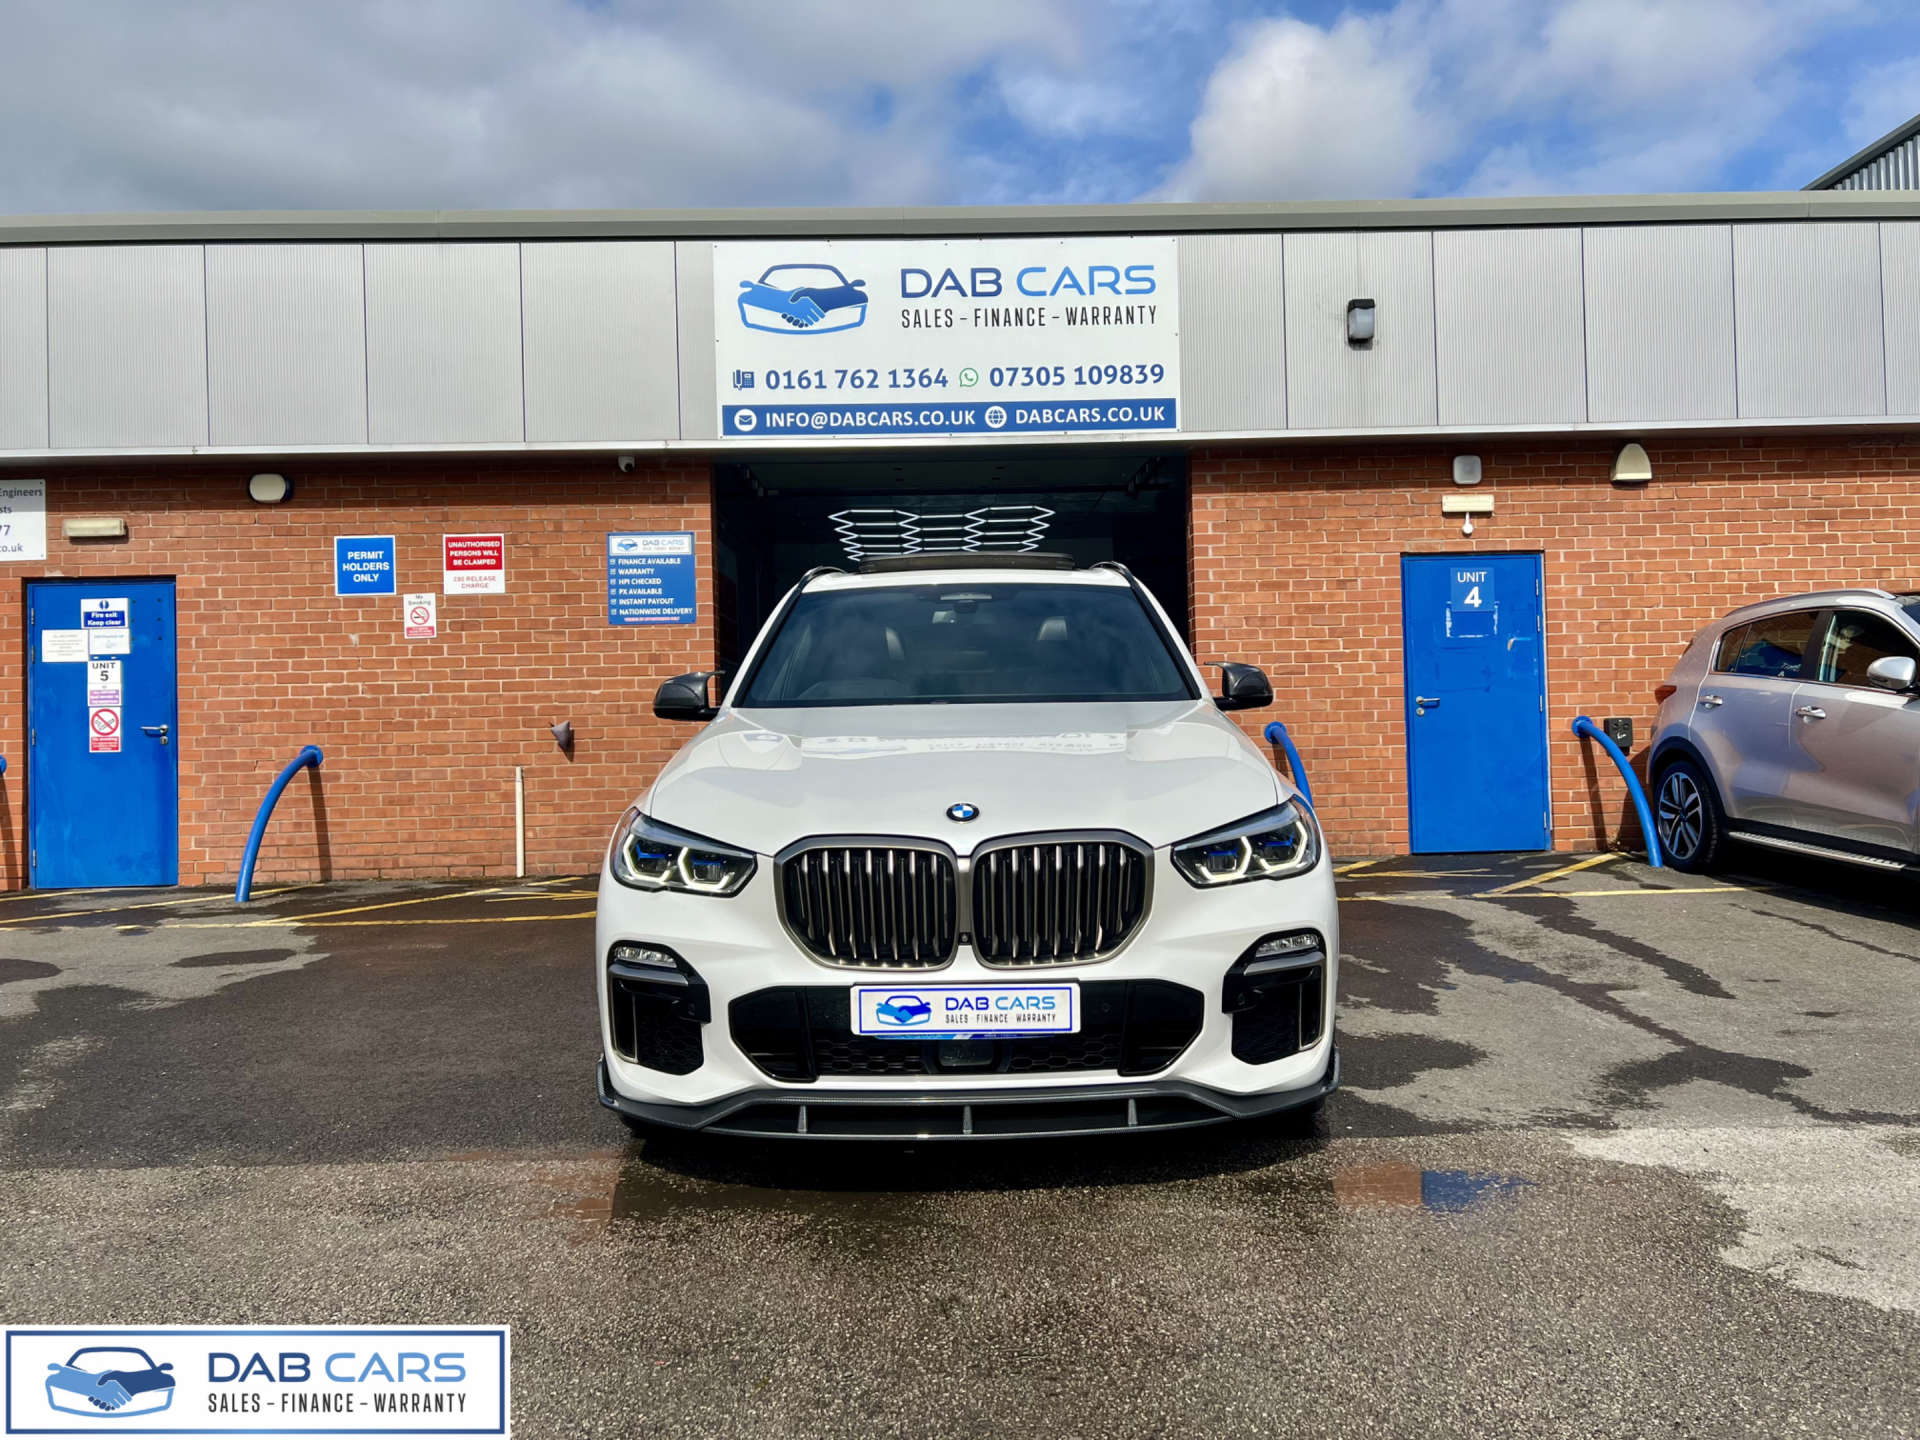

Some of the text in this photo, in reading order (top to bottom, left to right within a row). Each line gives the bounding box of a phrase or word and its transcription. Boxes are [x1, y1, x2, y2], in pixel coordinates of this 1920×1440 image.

[901, 264, 1157, 299] DAB CARS
[901, 307, 954, 329] SALES
[973, 306, 1047, 328] FINANCE
[1065, 304, 1158, 327] WARRANTY
[766, 367, 950, 391] 0161 762 1364
[989, 363, 1166, 388] 07305 109839
[766, 408, 976, 430] INFO@DABCARS.CO.UK
[1015, 405, 1166, 426] DABCARS.CO.UK
[0, 488, 43, 498] ngineers
[0, 542, 23, 552] o.uk
[347, 551, 384, 561] PERMIT
[647, 557, 681, 565] AVAILABLE
[342, 562, 390, 572] HOLDERS
[463, 558, 496, 566] CLAMPED
[353, 573, 380, 583] ONLY
[631, 577, 662, 585] CHECKED
[1457, 571, 1488, 583] UNIT
[629, 587, 663, 595] AVAILABLE
[648, 597, 675, 605] PAYOUT
[1464, 586, 1482, 608] 4
[662, 607, 693, 615] DELIVERY
[100, 670, 109, 681] 5
[945, 996, 1056, 1011] DAB CARS
[945, 1013, 1056, 1024] SALES FINANCE WARRANTY
